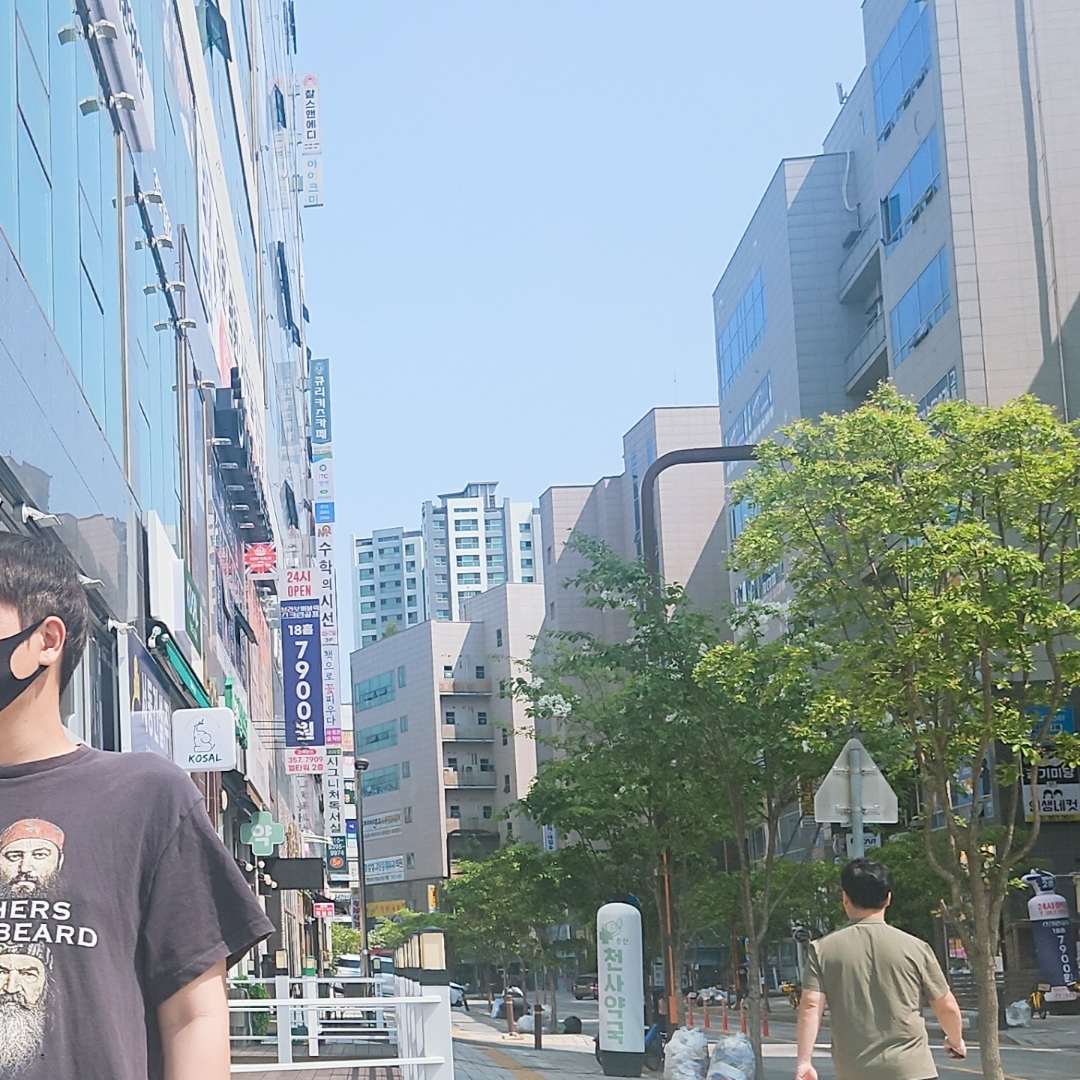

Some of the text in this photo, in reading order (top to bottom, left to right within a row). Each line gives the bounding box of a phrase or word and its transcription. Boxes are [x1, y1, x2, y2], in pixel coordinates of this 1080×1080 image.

[287, 570, 311, 583] 24시
[287, 585, 312, 597] OPEN
[188, 753, 223, 764] KOSAL
[250, 823, 273, 847] 약
[603, 947, 627, 1046] 천사약국
